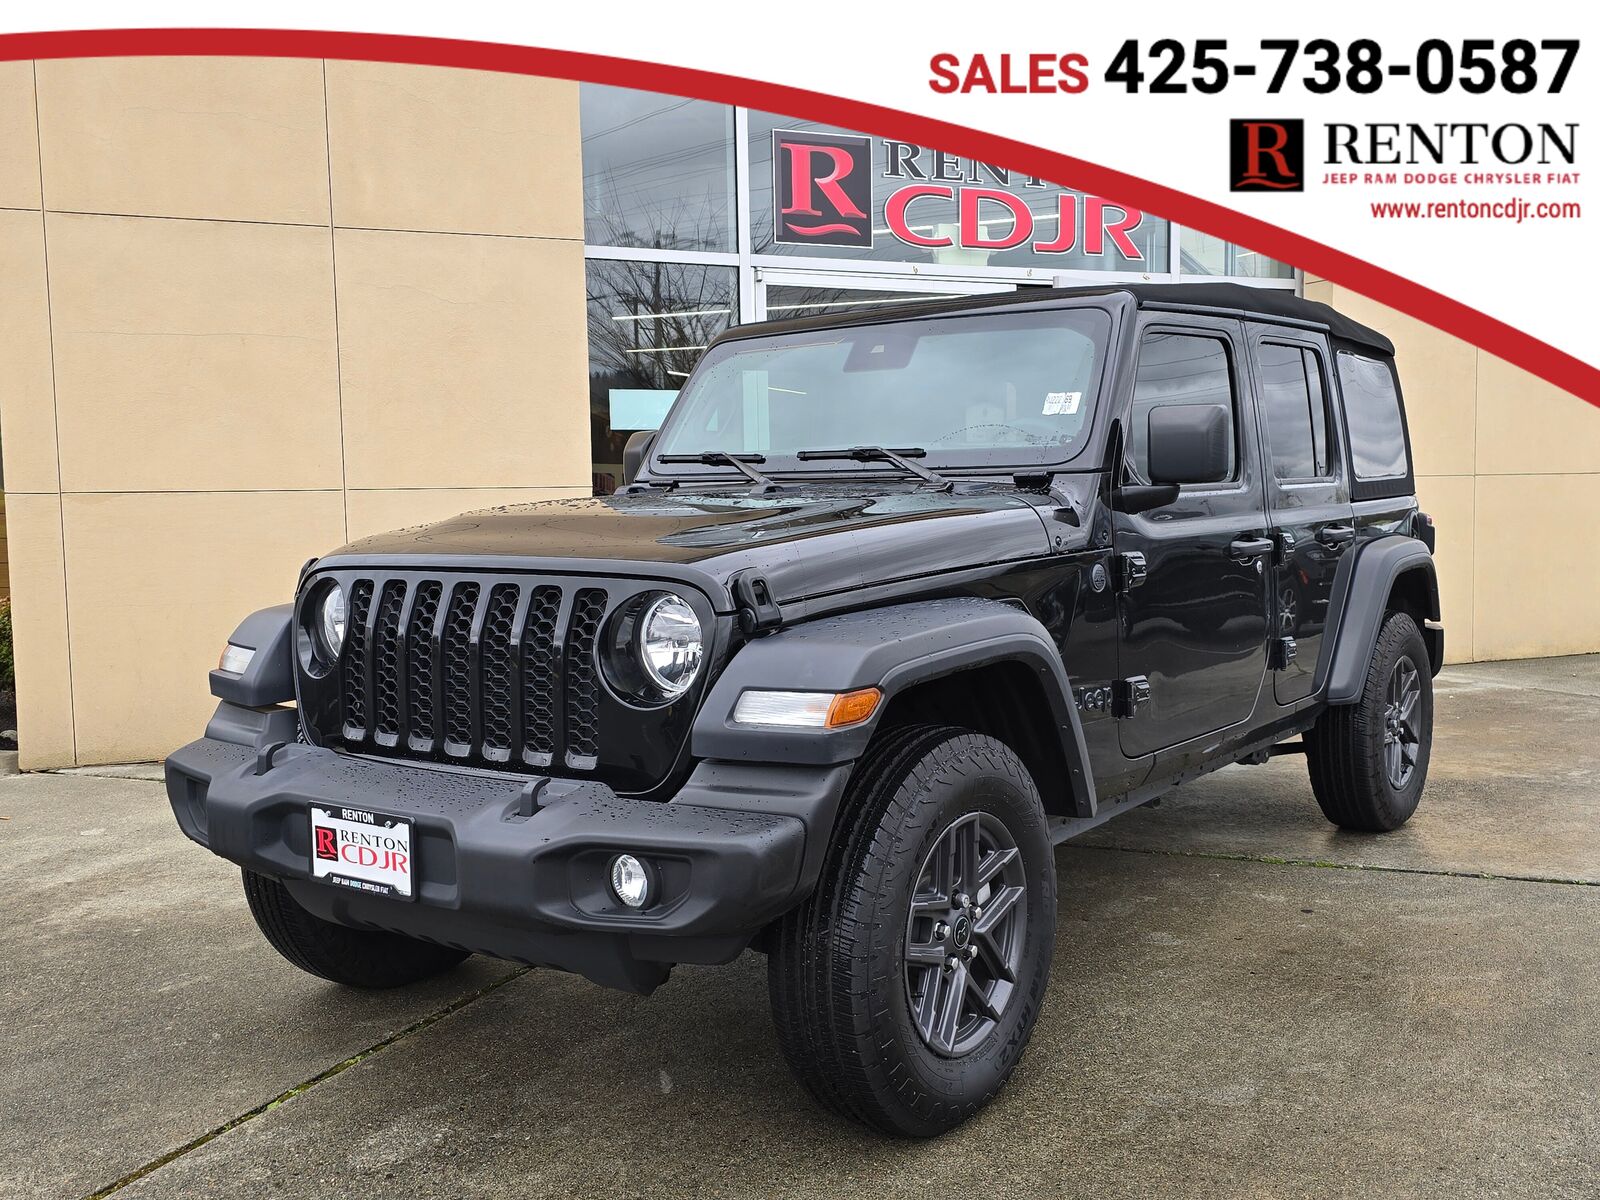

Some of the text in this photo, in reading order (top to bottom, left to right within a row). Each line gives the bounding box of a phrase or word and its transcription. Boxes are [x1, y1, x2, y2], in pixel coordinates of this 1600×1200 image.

[780, 143, 868, 219] R
[884, 183, 1145, 261] CDJR
[342, 809, 374, 824] RENTON
[341, 830, 407, 852] RENTON
[342, 844, 407, 873] CDJR
